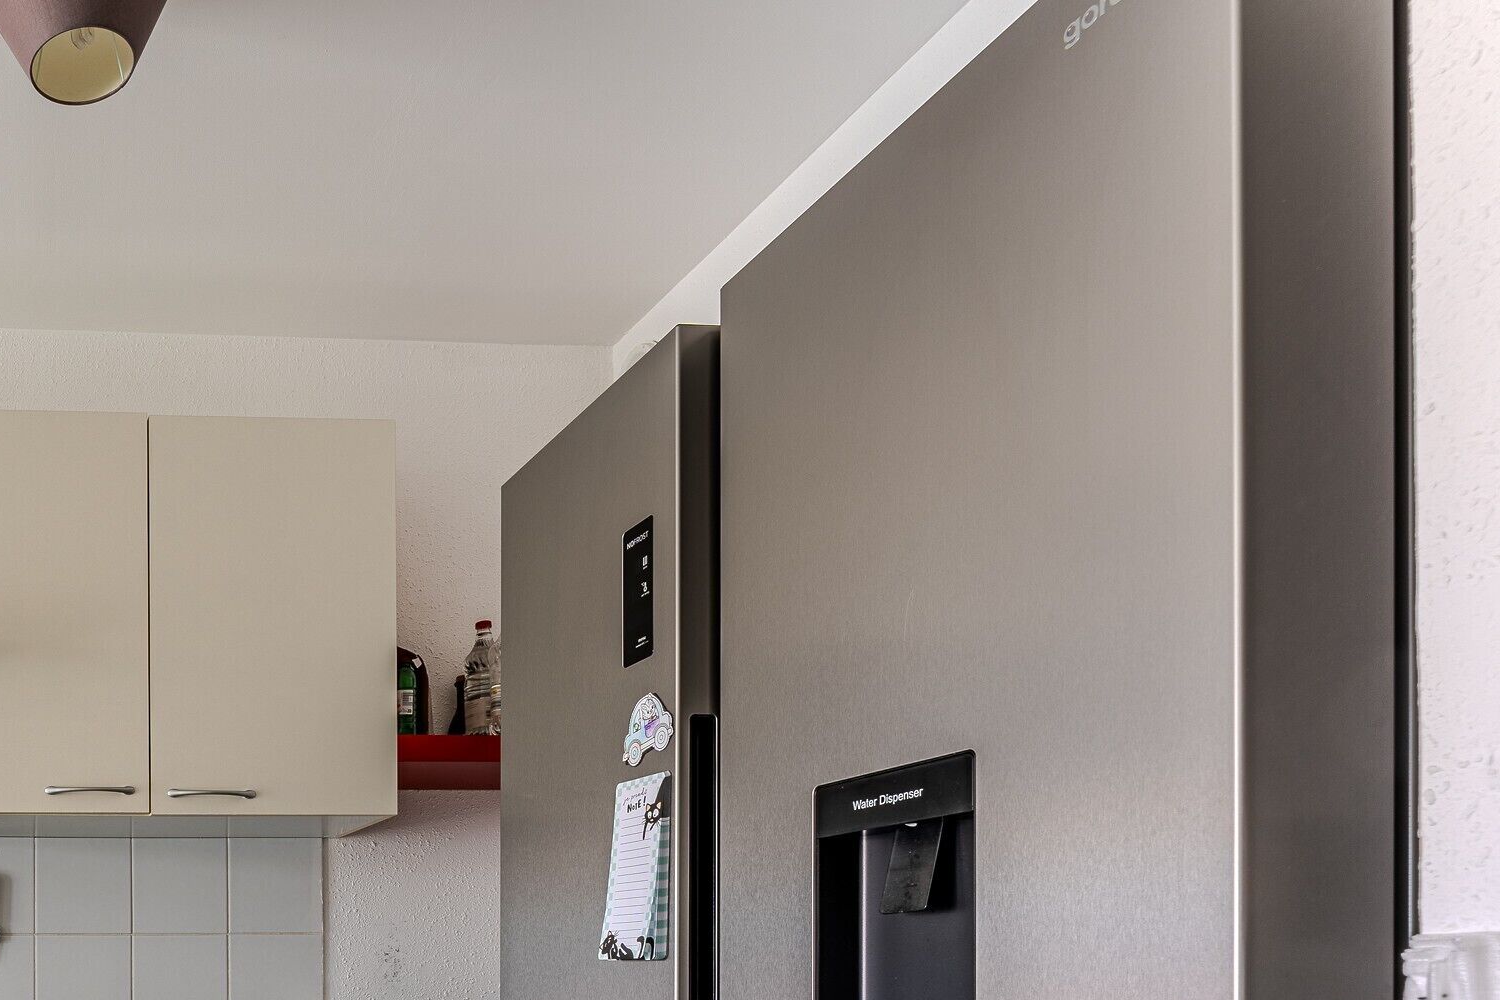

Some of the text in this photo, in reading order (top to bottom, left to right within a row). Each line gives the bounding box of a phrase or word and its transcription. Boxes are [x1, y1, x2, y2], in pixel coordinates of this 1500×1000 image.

[1063, 0, 1123, 50] gor
[626, 530, 649, 550] NOFROST
[852, 787, 924, 811] Water Dispenser
